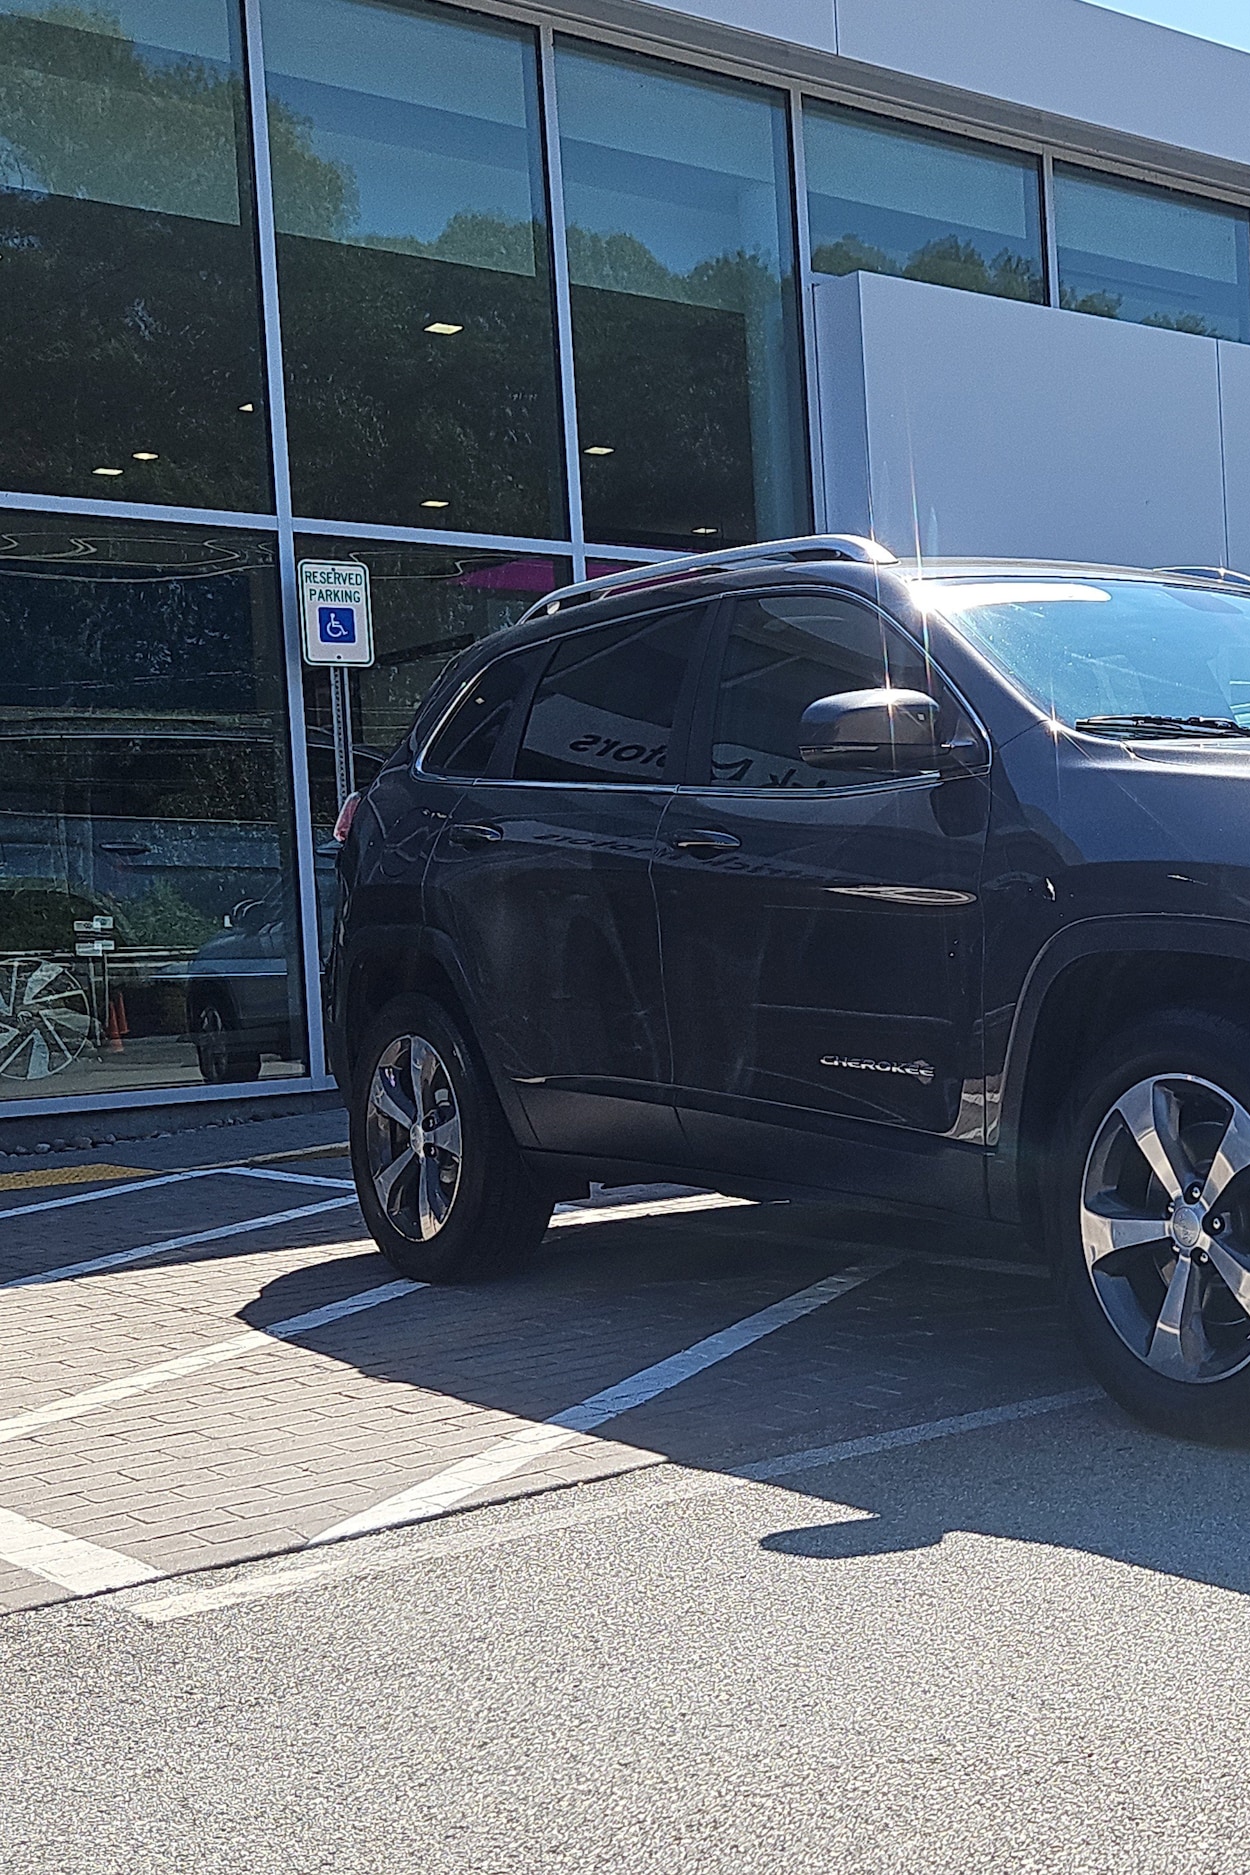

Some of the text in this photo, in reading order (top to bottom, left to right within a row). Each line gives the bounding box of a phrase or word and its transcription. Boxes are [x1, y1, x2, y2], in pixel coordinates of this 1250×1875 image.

[304, 570, 363, 586] RESERVED
[309, 588, 361, 603] PARKING
[820, 1054, 935, 1078] CHEROKEE
